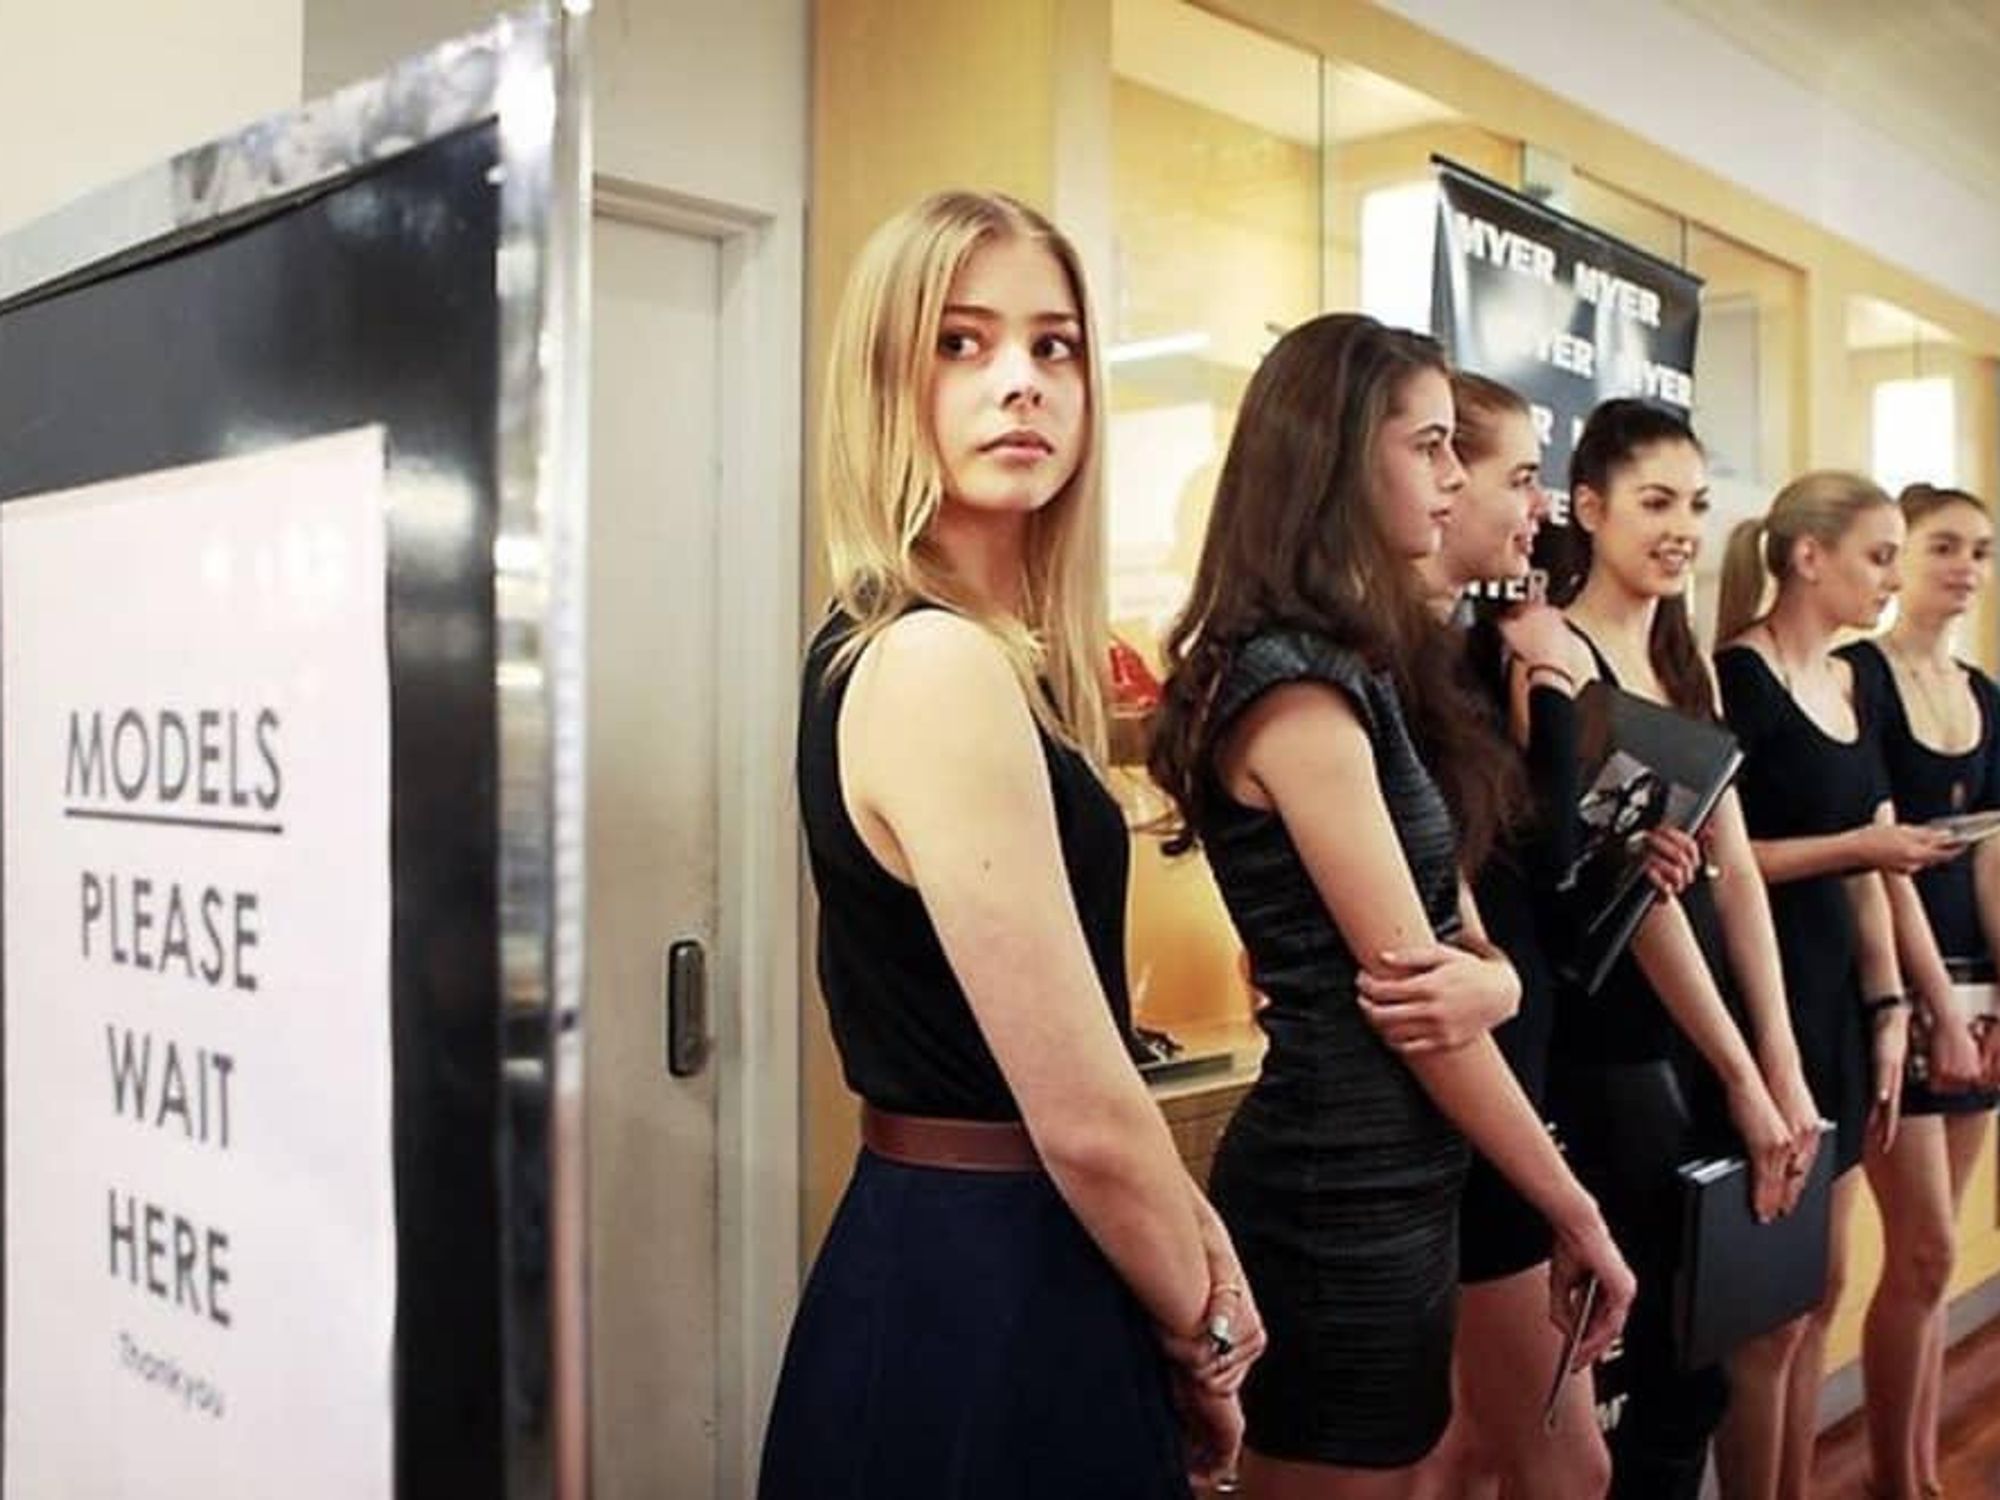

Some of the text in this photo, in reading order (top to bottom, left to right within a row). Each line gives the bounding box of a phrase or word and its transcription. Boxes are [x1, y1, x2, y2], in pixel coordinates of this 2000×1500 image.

[1452, 212, 1661, 328] MYER MYER
[65, 708, 282, 811] MODELS
[81, 870, 258, 991] PLEASE
[106, 1023, 235, 1149] WAIT
[108, 1188, 231, 1328] HERE
